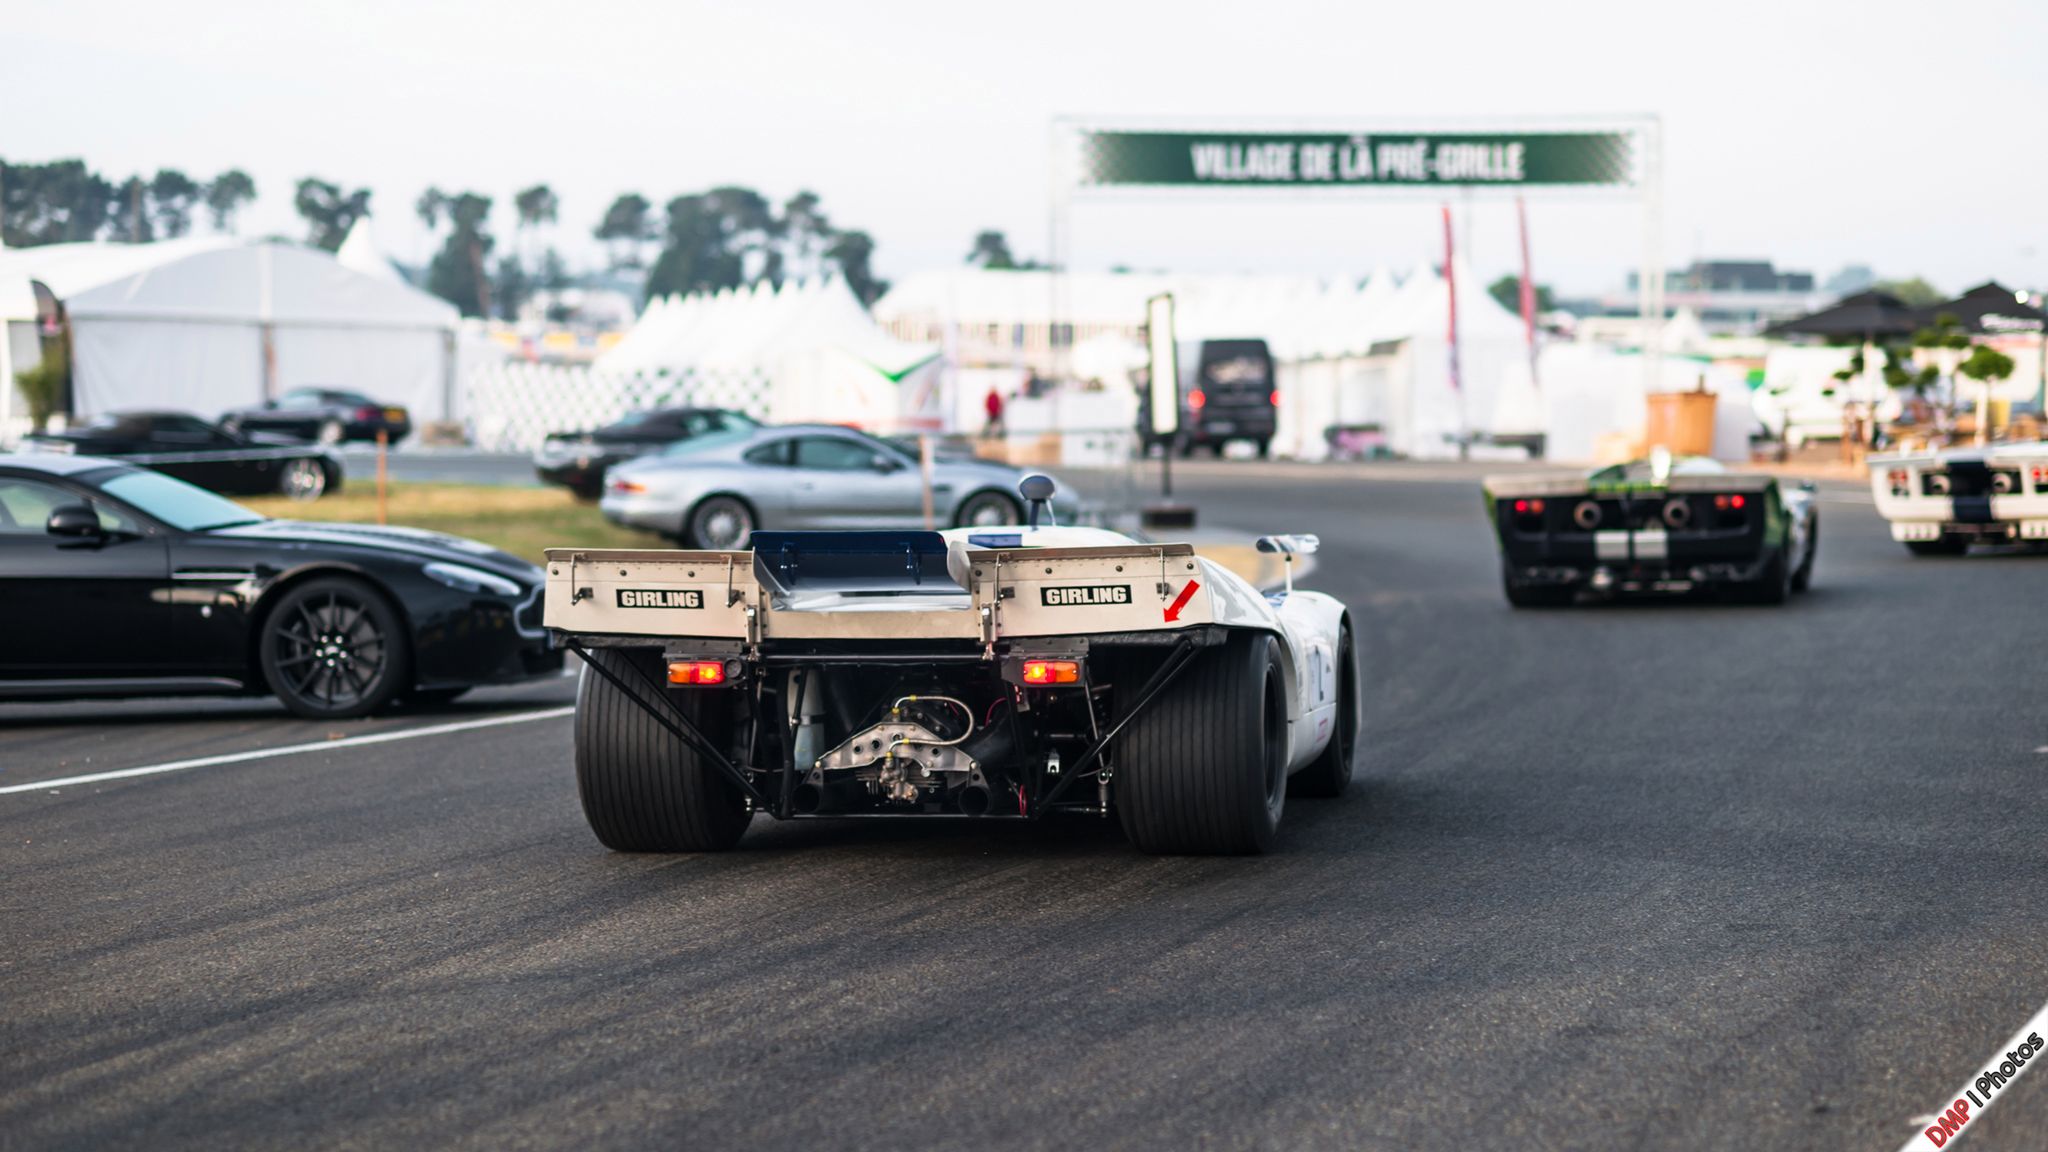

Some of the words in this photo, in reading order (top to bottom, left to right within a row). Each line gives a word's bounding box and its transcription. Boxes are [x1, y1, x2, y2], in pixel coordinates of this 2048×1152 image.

[1191, 143, 1295, 180] VILLAGE
[1301, 143, 1334, 180] DE
[1377, 138, 1525, 180] PRÉ-GRILLE
[621, 591, 699, 607] GIRLING
[1045, 587, 1127, 605] GIRLING
